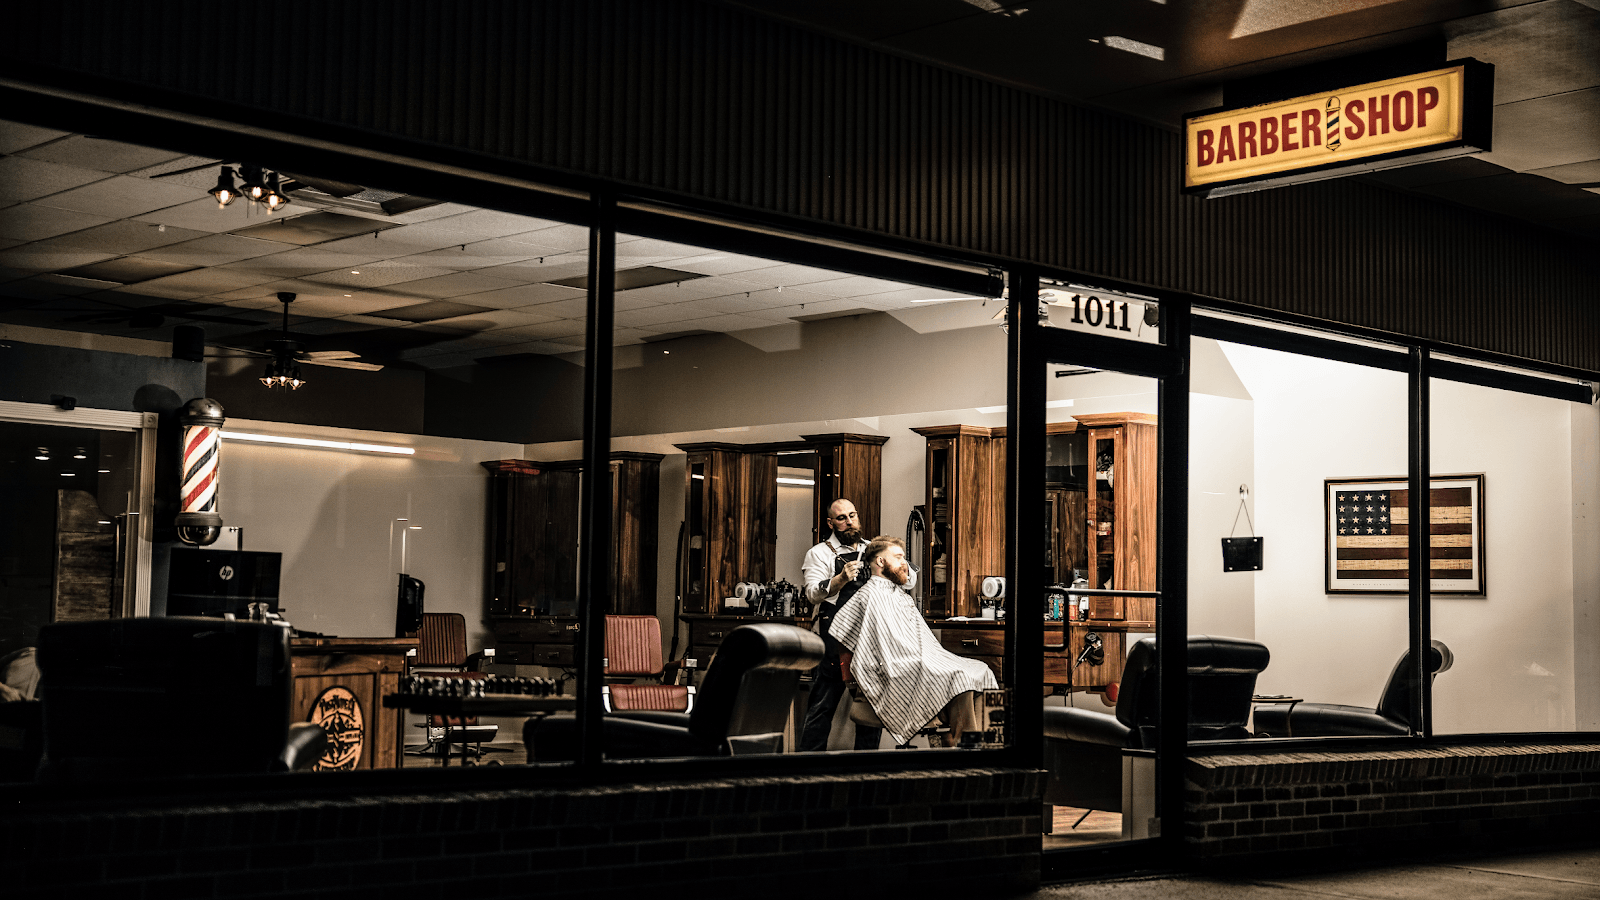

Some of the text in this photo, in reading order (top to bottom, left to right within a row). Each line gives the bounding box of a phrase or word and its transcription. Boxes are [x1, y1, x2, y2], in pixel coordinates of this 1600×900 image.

[1197, 86, 1439, 168] BARBER SHOP
[1070, 294, 1131, 332] 1011
